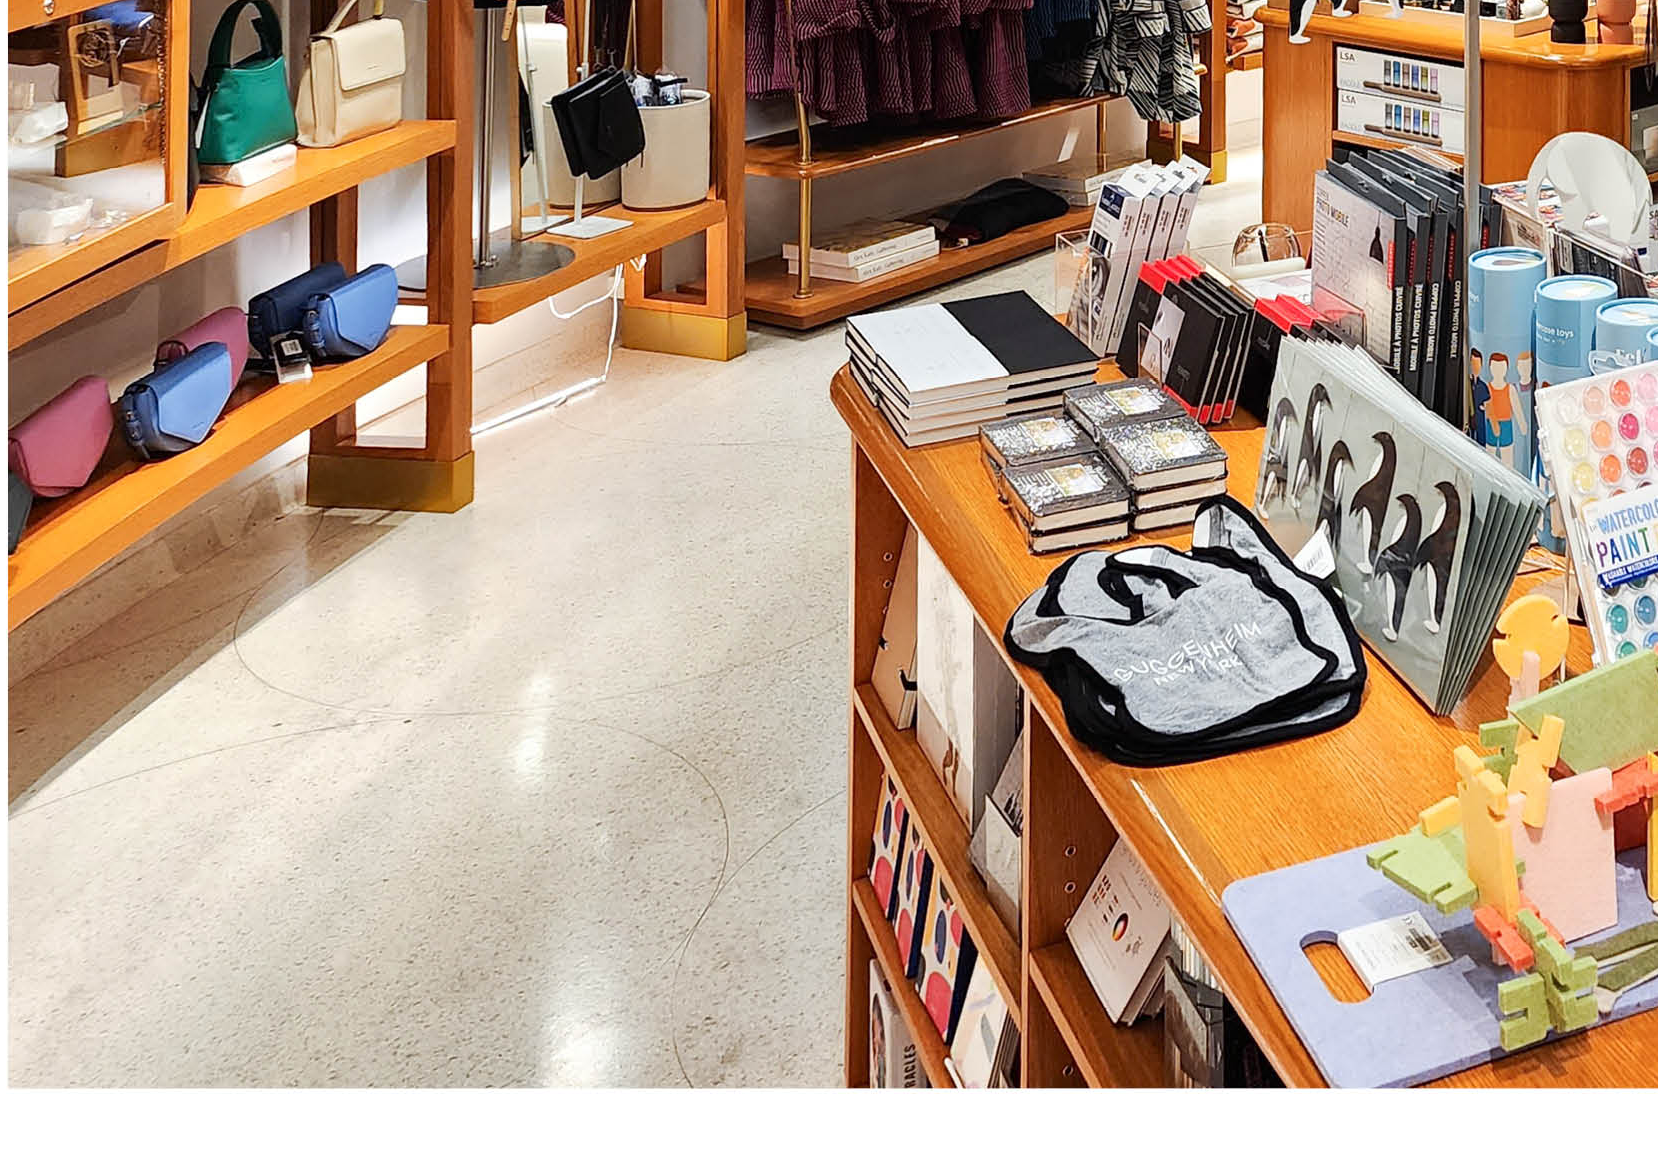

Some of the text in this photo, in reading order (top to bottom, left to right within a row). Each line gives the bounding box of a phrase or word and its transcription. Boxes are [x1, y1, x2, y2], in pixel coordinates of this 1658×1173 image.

[1340, 51, 1356, 62] LSA
[1341, 94, 1357, 105] LSA
[1394, 311, 1403, 340] PHOTOS
[1412, 309, 1422, 337] PHOTOS
[1426, 283, 1440, 363] COPPER PHOTO MOBILE
[1450, 280, 1462, 359] COPPER PHOTO MOBILE
[1556, 328, 1575, 339] toys
[1409, 344, 1419, 371] MOBILE
[1596, 527, 1650, 568] PAINT
[1113, 622, 1263, 682] GUGGENHEIM
